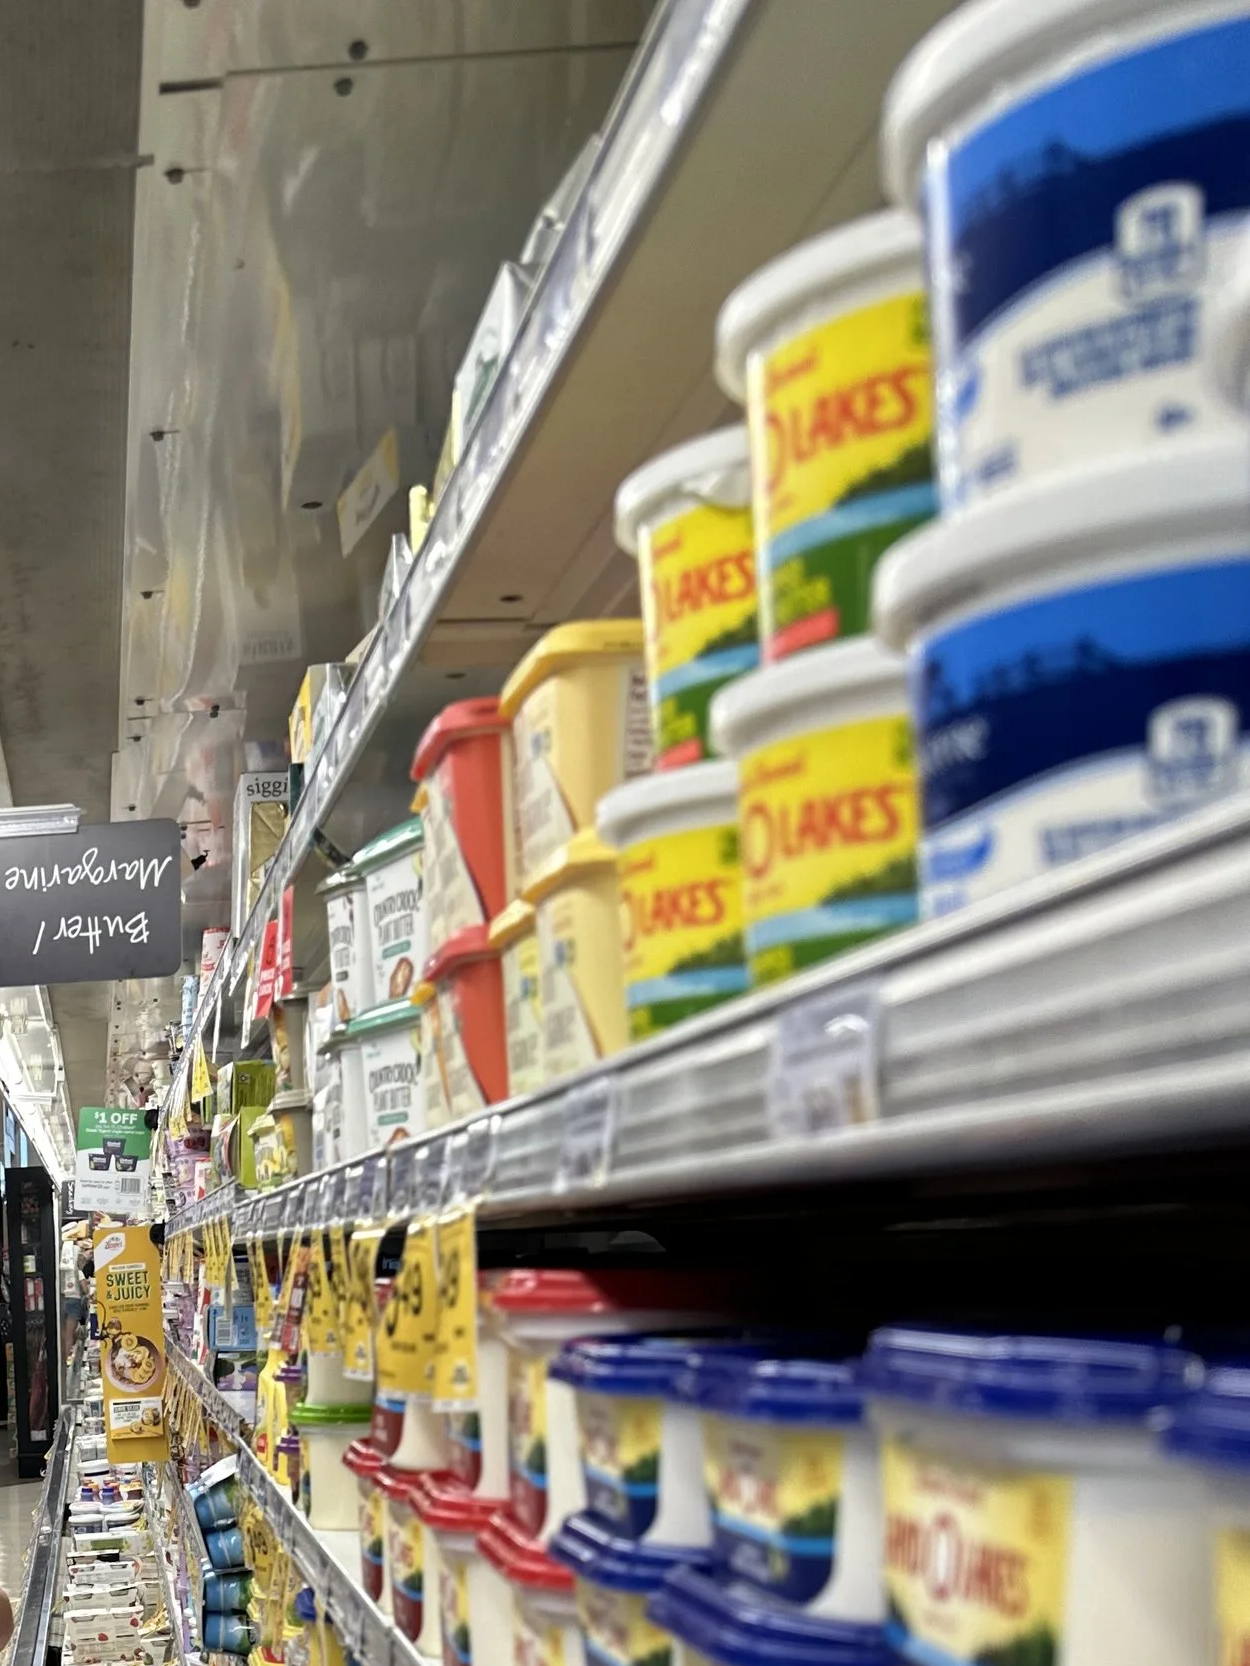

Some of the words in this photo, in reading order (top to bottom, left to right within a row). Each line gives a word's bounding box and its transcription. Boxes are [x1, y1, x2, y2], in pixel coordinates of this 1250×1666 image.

[790, 370, 918, 463] LAKES
[664, 550, 756, 622] LAKES
[246, 777, 288, 798] siggi
[782, 783, 902, 859] LAKES
[5, 847, 173, 893] Margarine
[640, 879, 725, 937] LAKES
[53, 912, 149, 954] Butter
[110, 1112, 138, 1125] OFF
[106, 1271, 149, 1287] SWEET
[113, 1285, 151, 1301] JUICY
